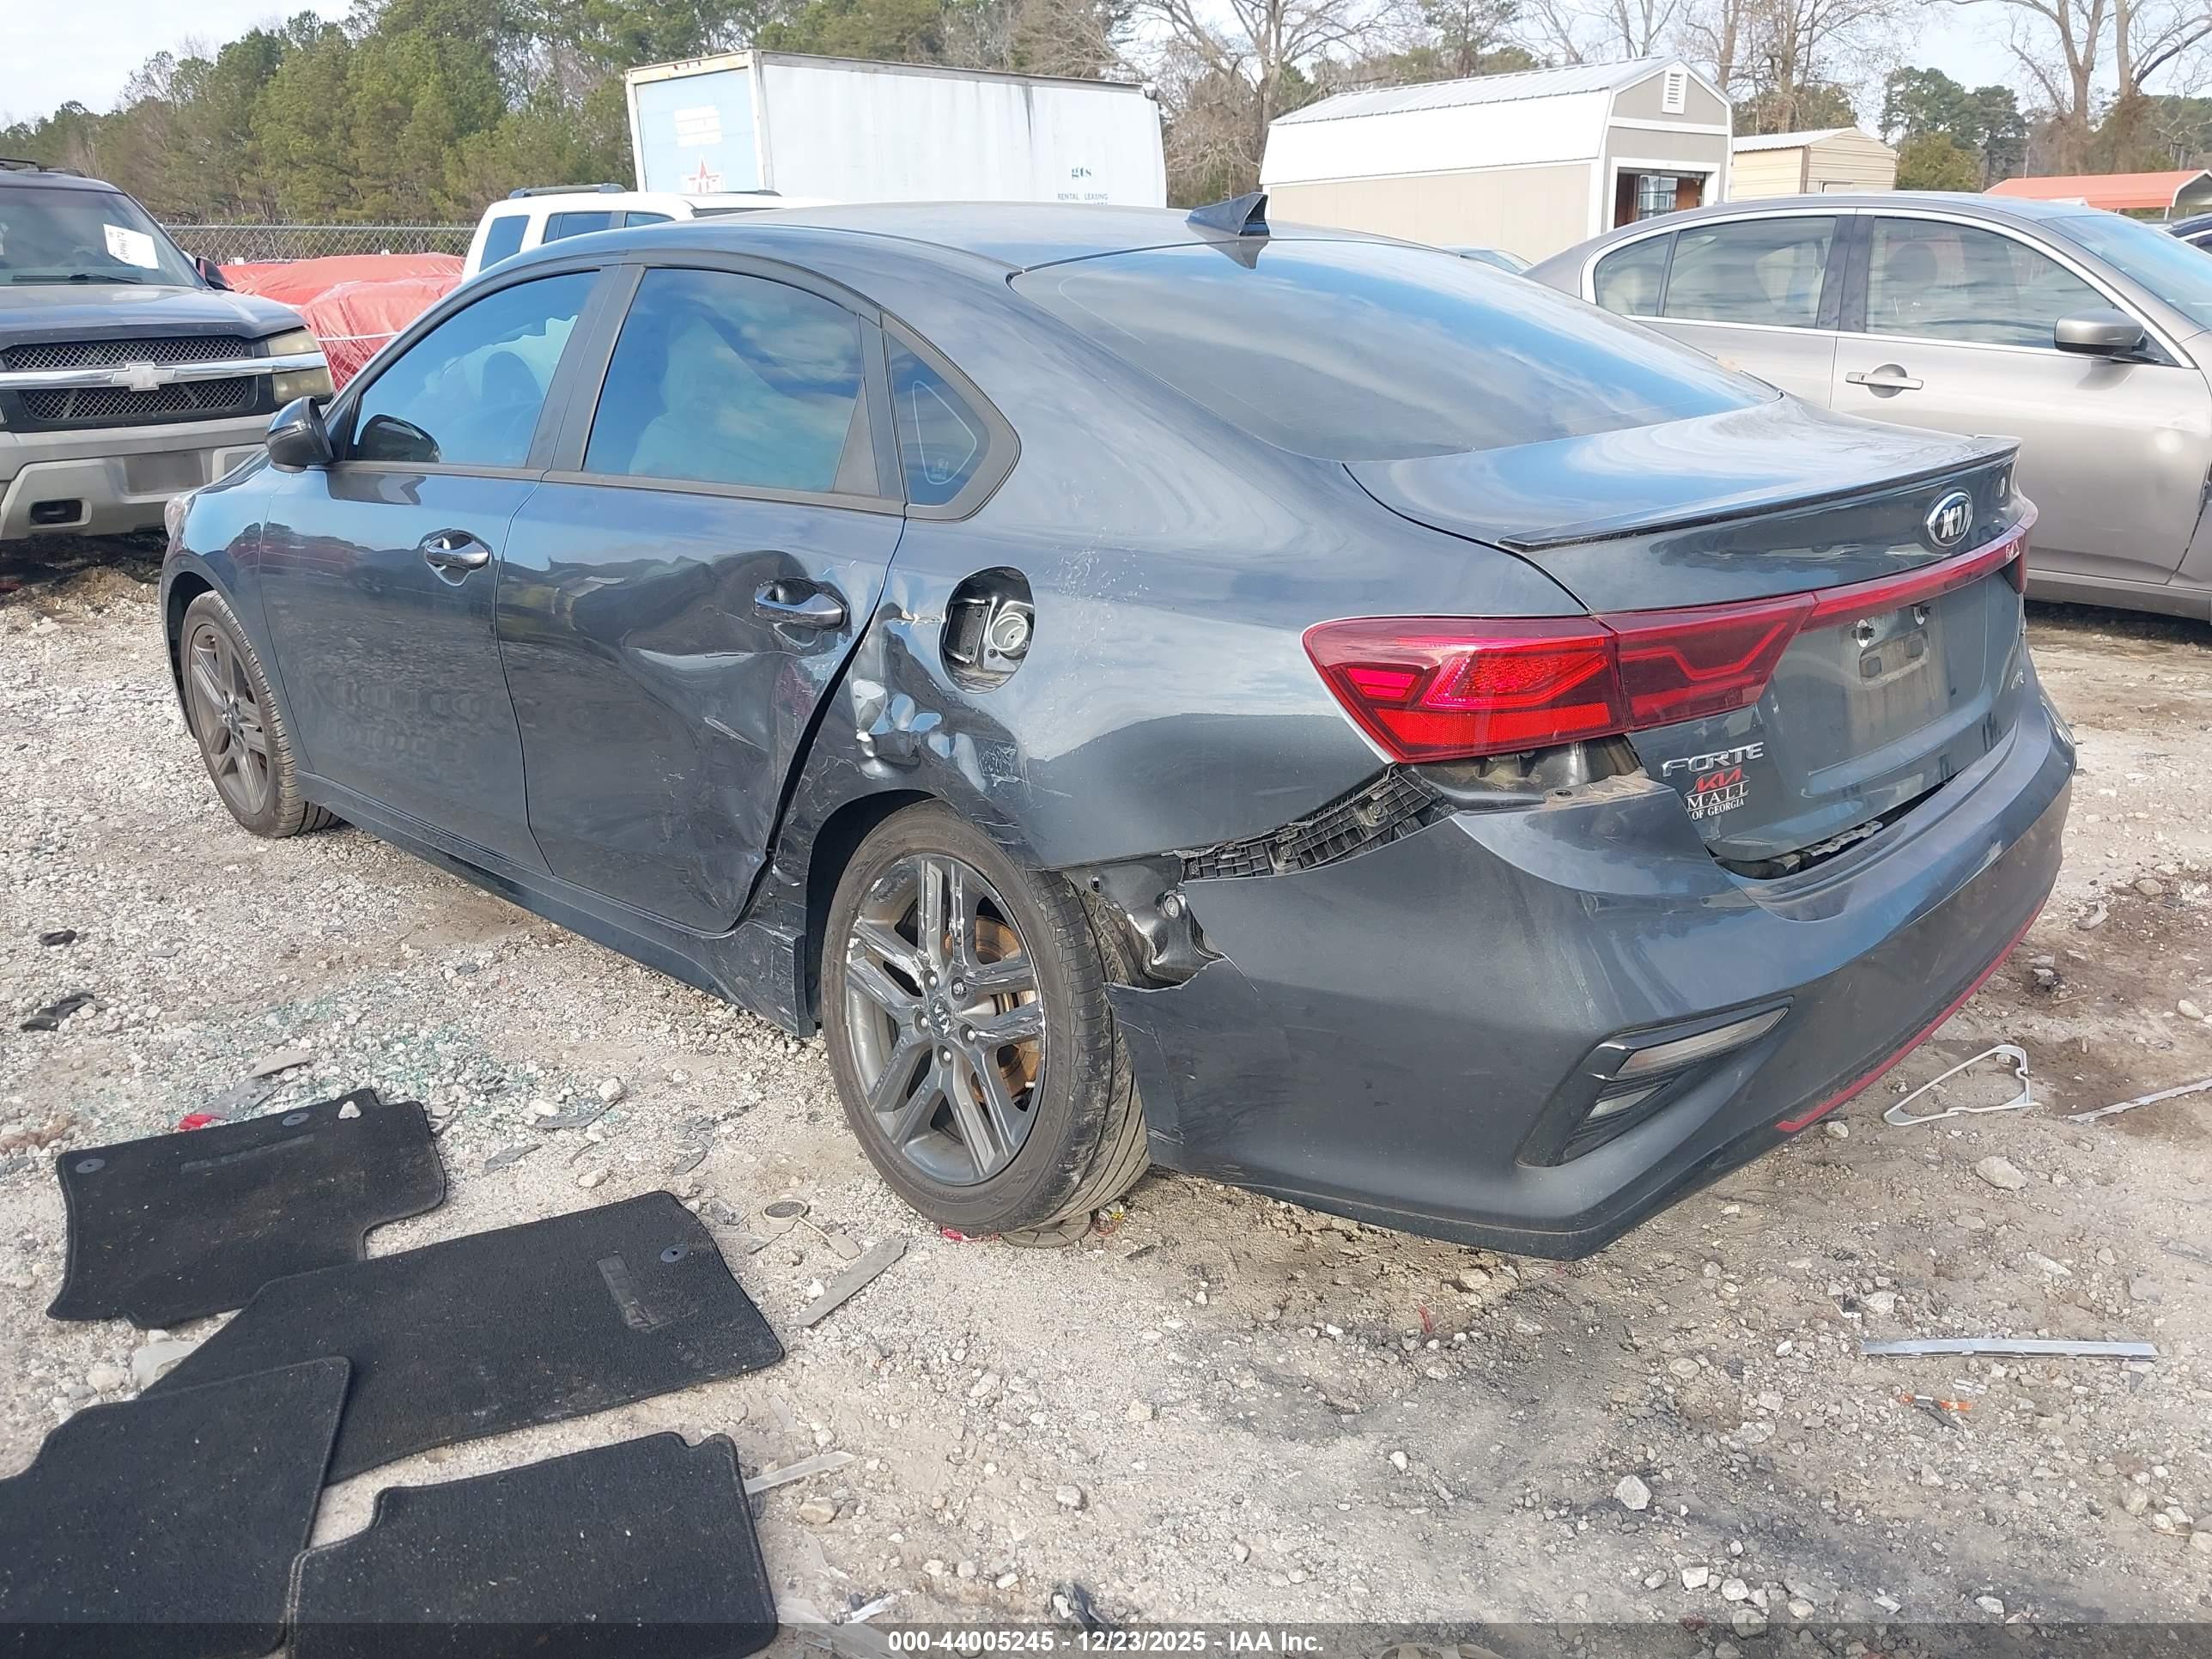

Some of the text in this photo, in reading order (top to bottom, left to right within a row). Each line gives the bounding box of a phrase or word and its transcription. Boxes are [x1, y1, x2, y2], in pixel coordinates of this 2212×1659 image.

[1662, 741, 1764, 778] FORTE
[1692, 798, 1745, 821] OF GEORGIA
